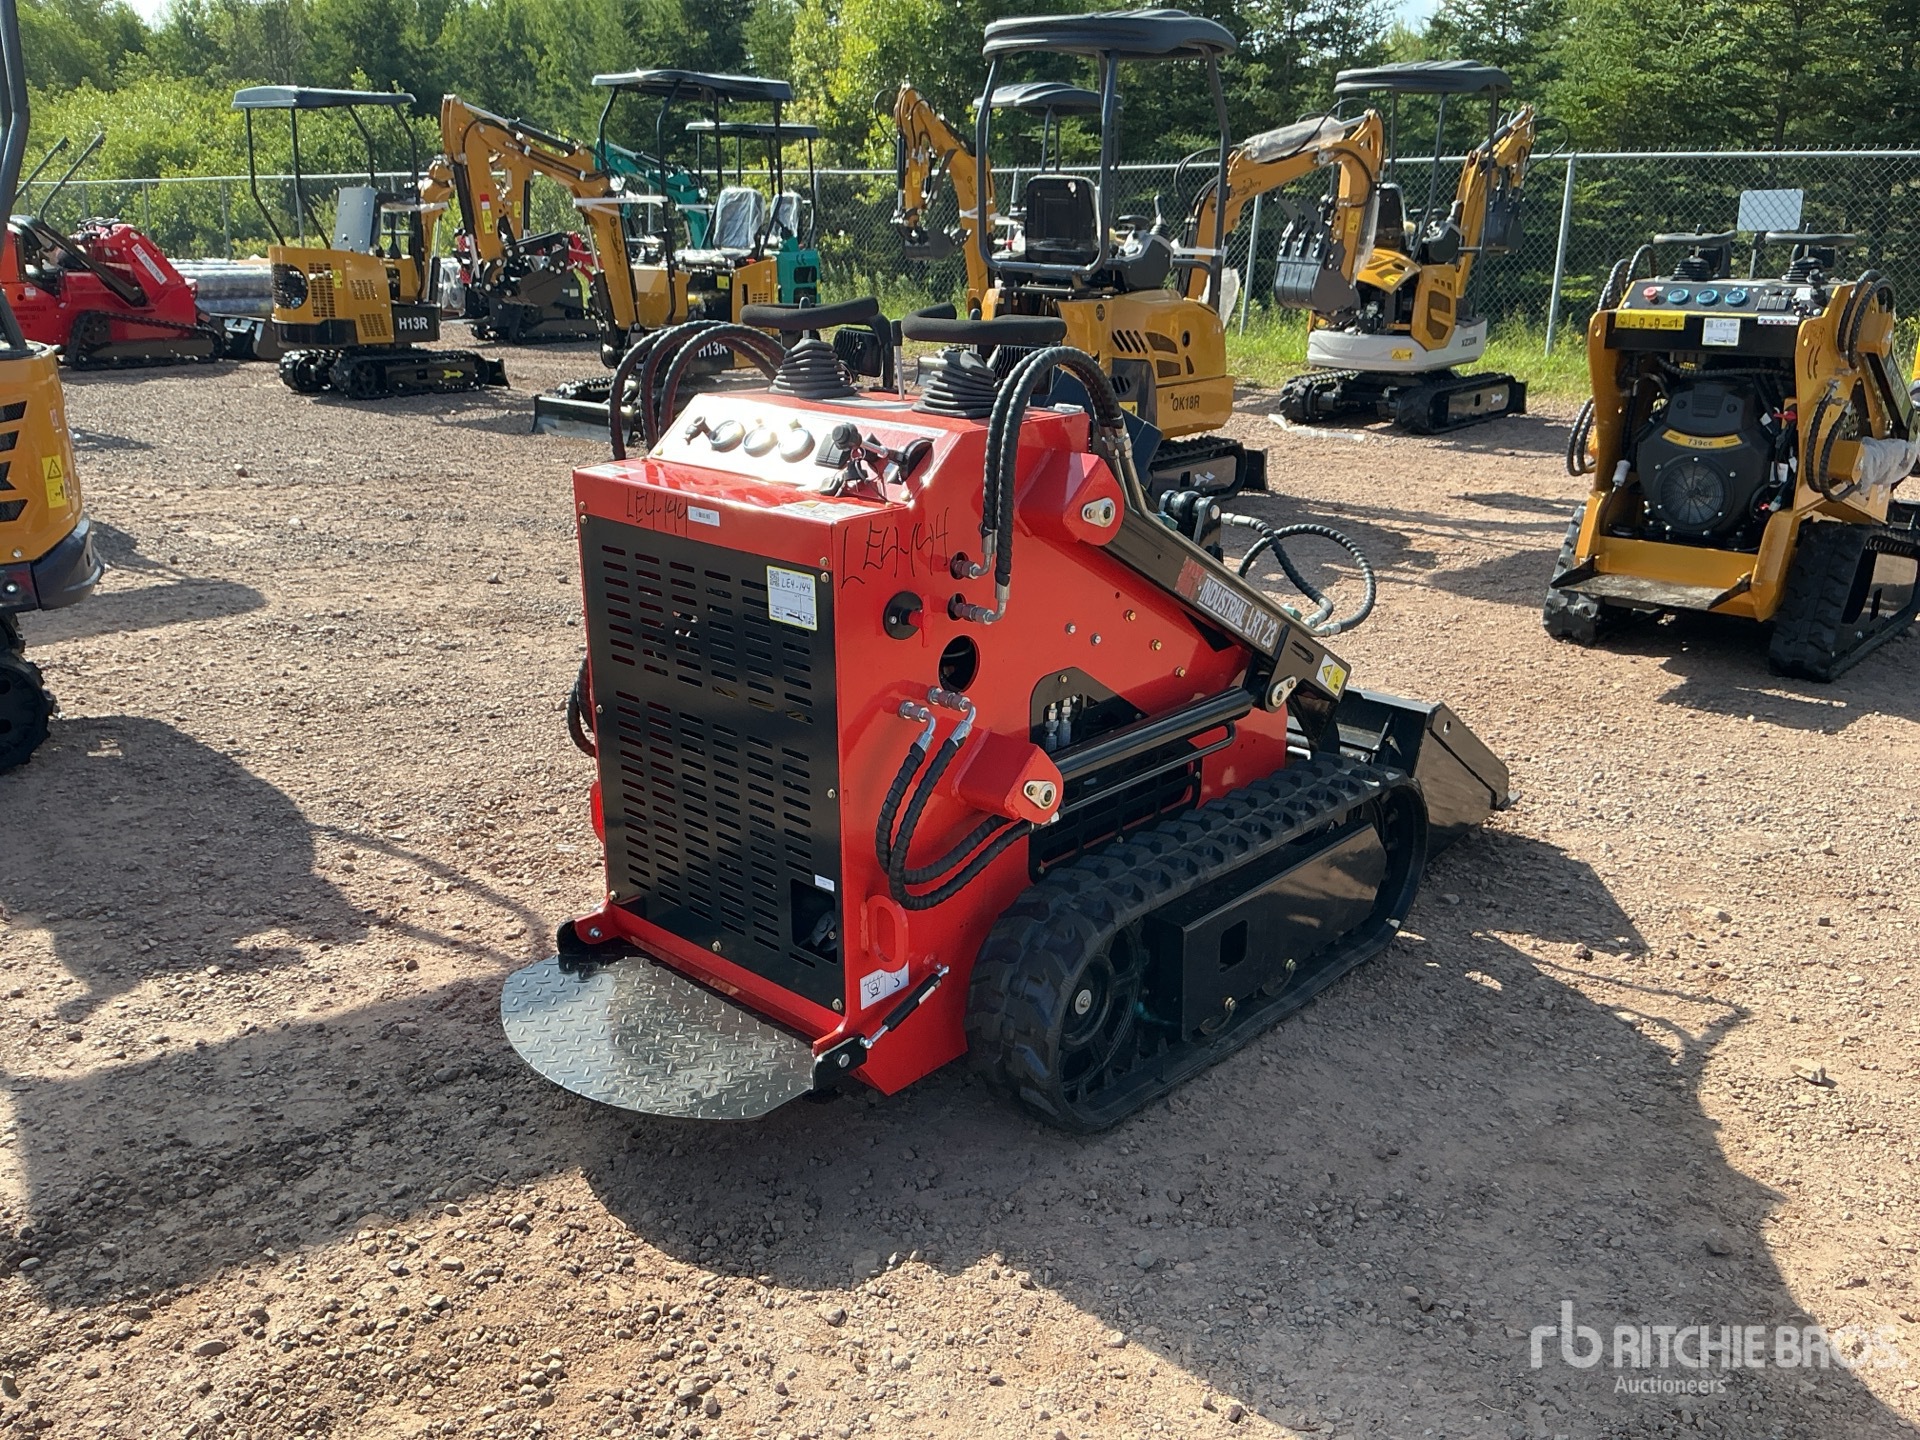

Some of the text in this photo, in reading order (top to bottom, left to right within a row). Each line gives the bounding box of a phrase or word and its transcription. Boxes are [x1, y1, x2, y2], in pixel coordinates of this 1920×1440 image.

[398, 316, 429, 330] H13R
[697, 341, 729, 358] H13R
[1171, 394, 1200, 412] QK18R
[1688, 438, 1713, 447] 739cc
[626, 487, 688, 539] LE4-144
[781, 578, 811, 593] LE4-144
[1199, 578, 1279, 649] INDUSTRIAL LRT 23
